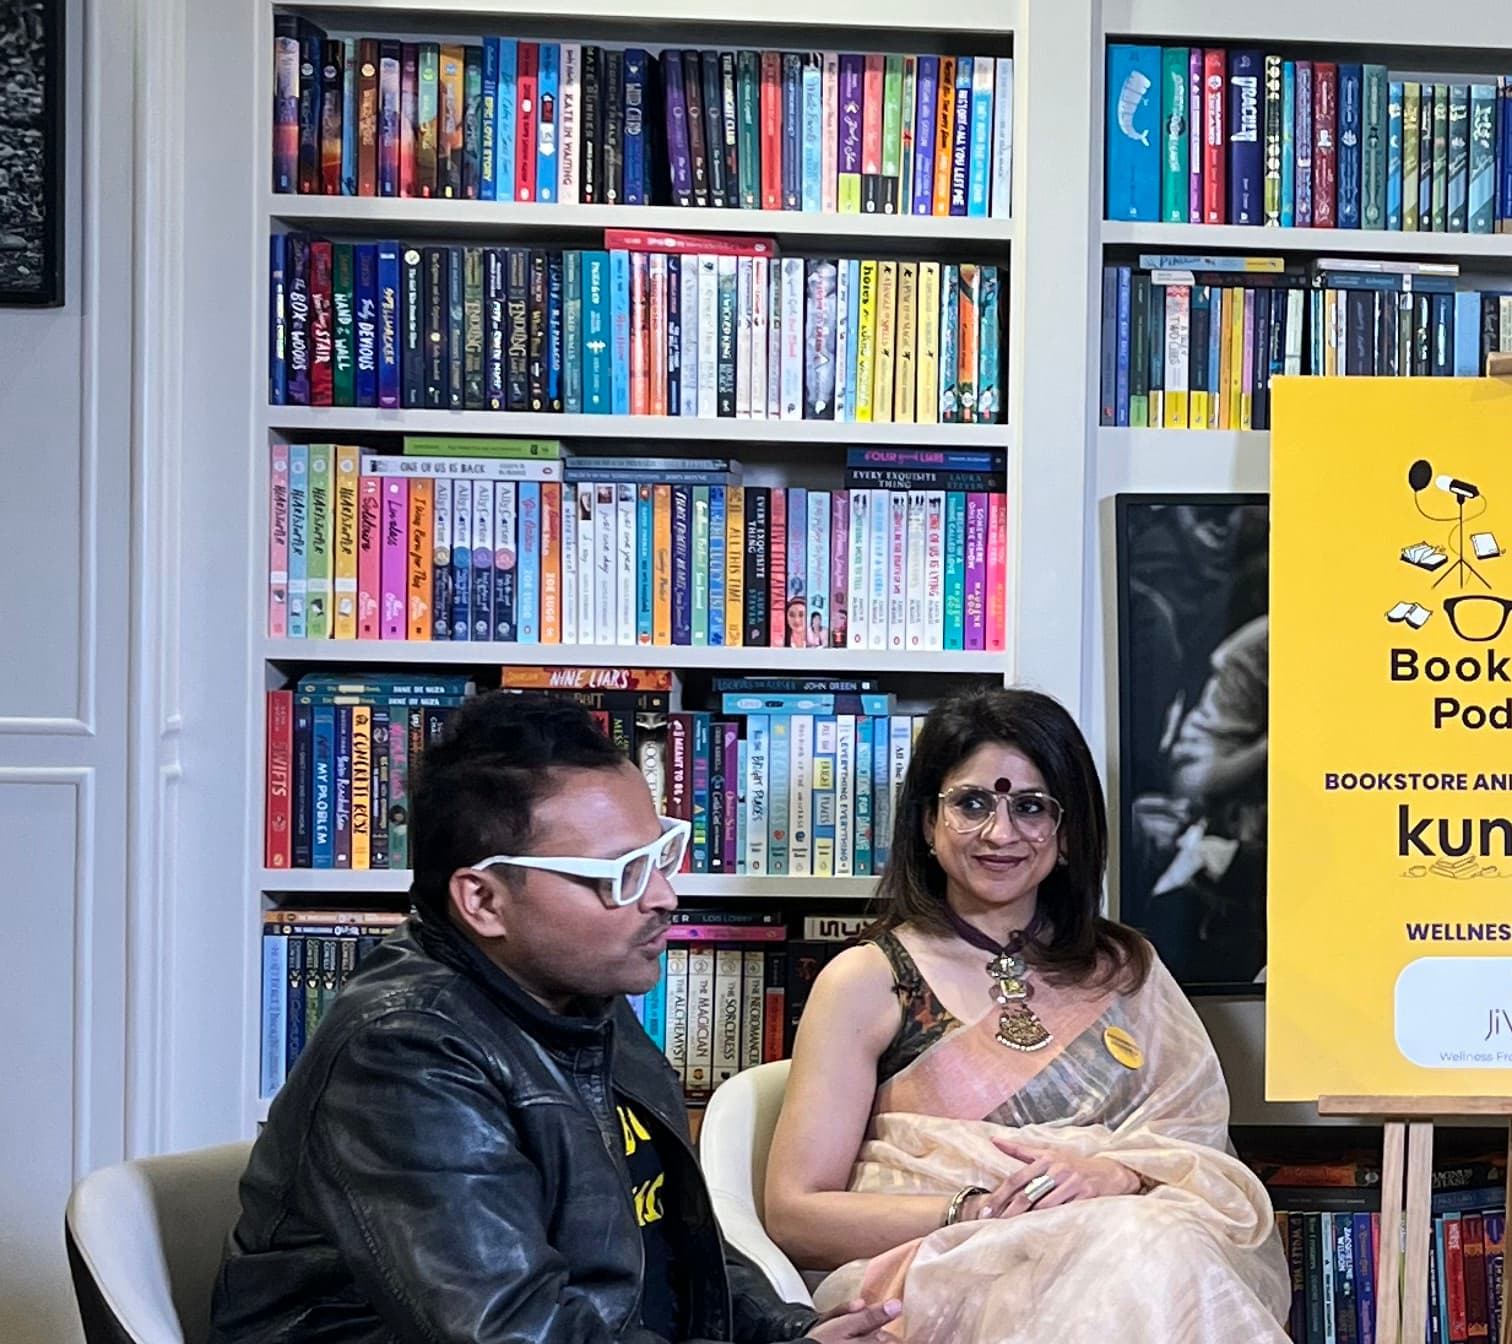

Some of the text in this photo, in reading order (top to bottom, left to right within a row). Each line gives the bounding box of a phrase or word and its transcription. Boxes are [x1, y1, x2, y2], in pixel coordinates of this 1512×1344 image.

[1231, 77, 1257, 142] DRACULA
[563, 93, 574, 186] KATE IN WAITING
[291, 292, 309, 370] BOX WOODS
[314, 329, 331, 364] STAIR
[400, 462, 486, 474] ONE OF US IS BACK
[853, 471, 882, 482] EVERY
[886, 472, 937, 482] EXQUISITE
[879, 479, 912, 489] THING
[728, 527, 741, 604] ALL THIS TIME
[747, 520, 756, 554] THING
[756, 495, 765, 624] EVERY EXQUISITE LAURA
[549, 670, 630, 689] NINE LIARS
[353, 732, 369, 836] CONCRETE ROSE
[673, 738, 686, 795] MEANT TO BE
[895, 745, 905, 778] All the
[1324, 773, 1468, 793] BOOKSTORE
[316, 762, 329, 845] MY PROBLEM
[751, 979, 760, 995] THE
[673, 979, 686, 1063] THE ALCHEMYST
[696, 980, 710, 1058] THE MAGICIAN
[723, 982, 737, 1061] THE SORCERESS
[1439, 1049, 1490, 1063] Wellness
